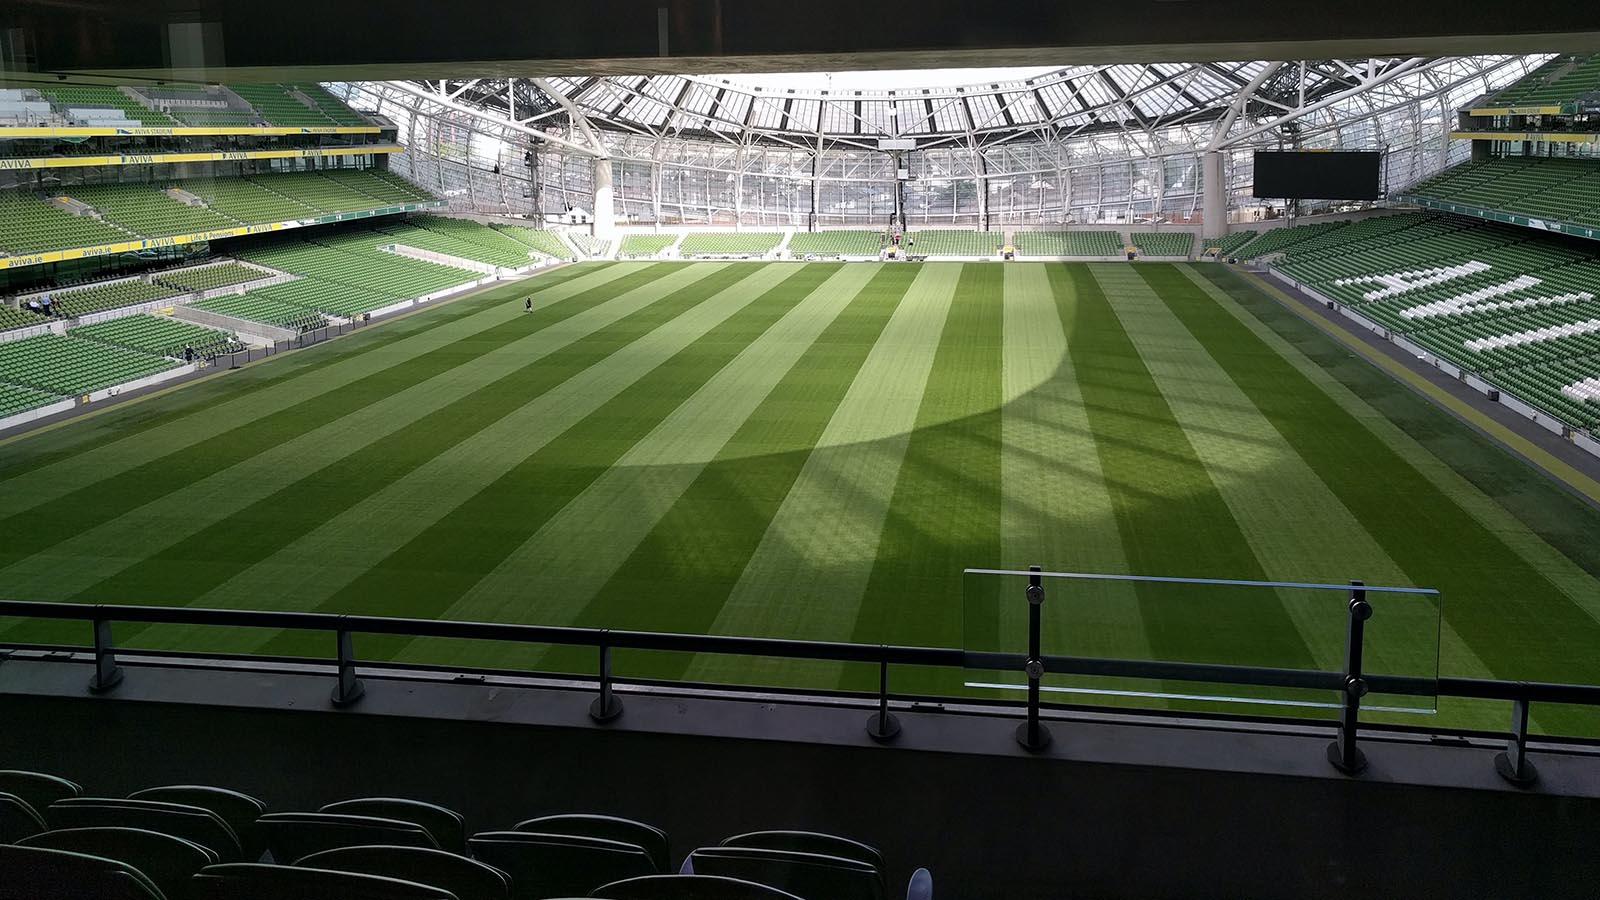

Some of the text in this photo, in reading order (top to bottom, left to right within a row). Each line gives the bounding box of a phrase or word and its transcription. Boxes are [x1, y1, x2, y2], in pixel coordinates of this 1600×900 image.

[129, 155, 153, 164] AVIVA
[228, 152, 248, 160] AVIVA
[0, 159, 32, 169] AVIVA
[253, 224, 273, 233] AVIVA
[190, 233, 202, 241] Life
[209, 231, 234, 239] Pensions
[150, 237, 175, 246] AVIVA
[82, 247, 112, 257] aviva.ie
[8, 255, 43, 267] aviva.ie
